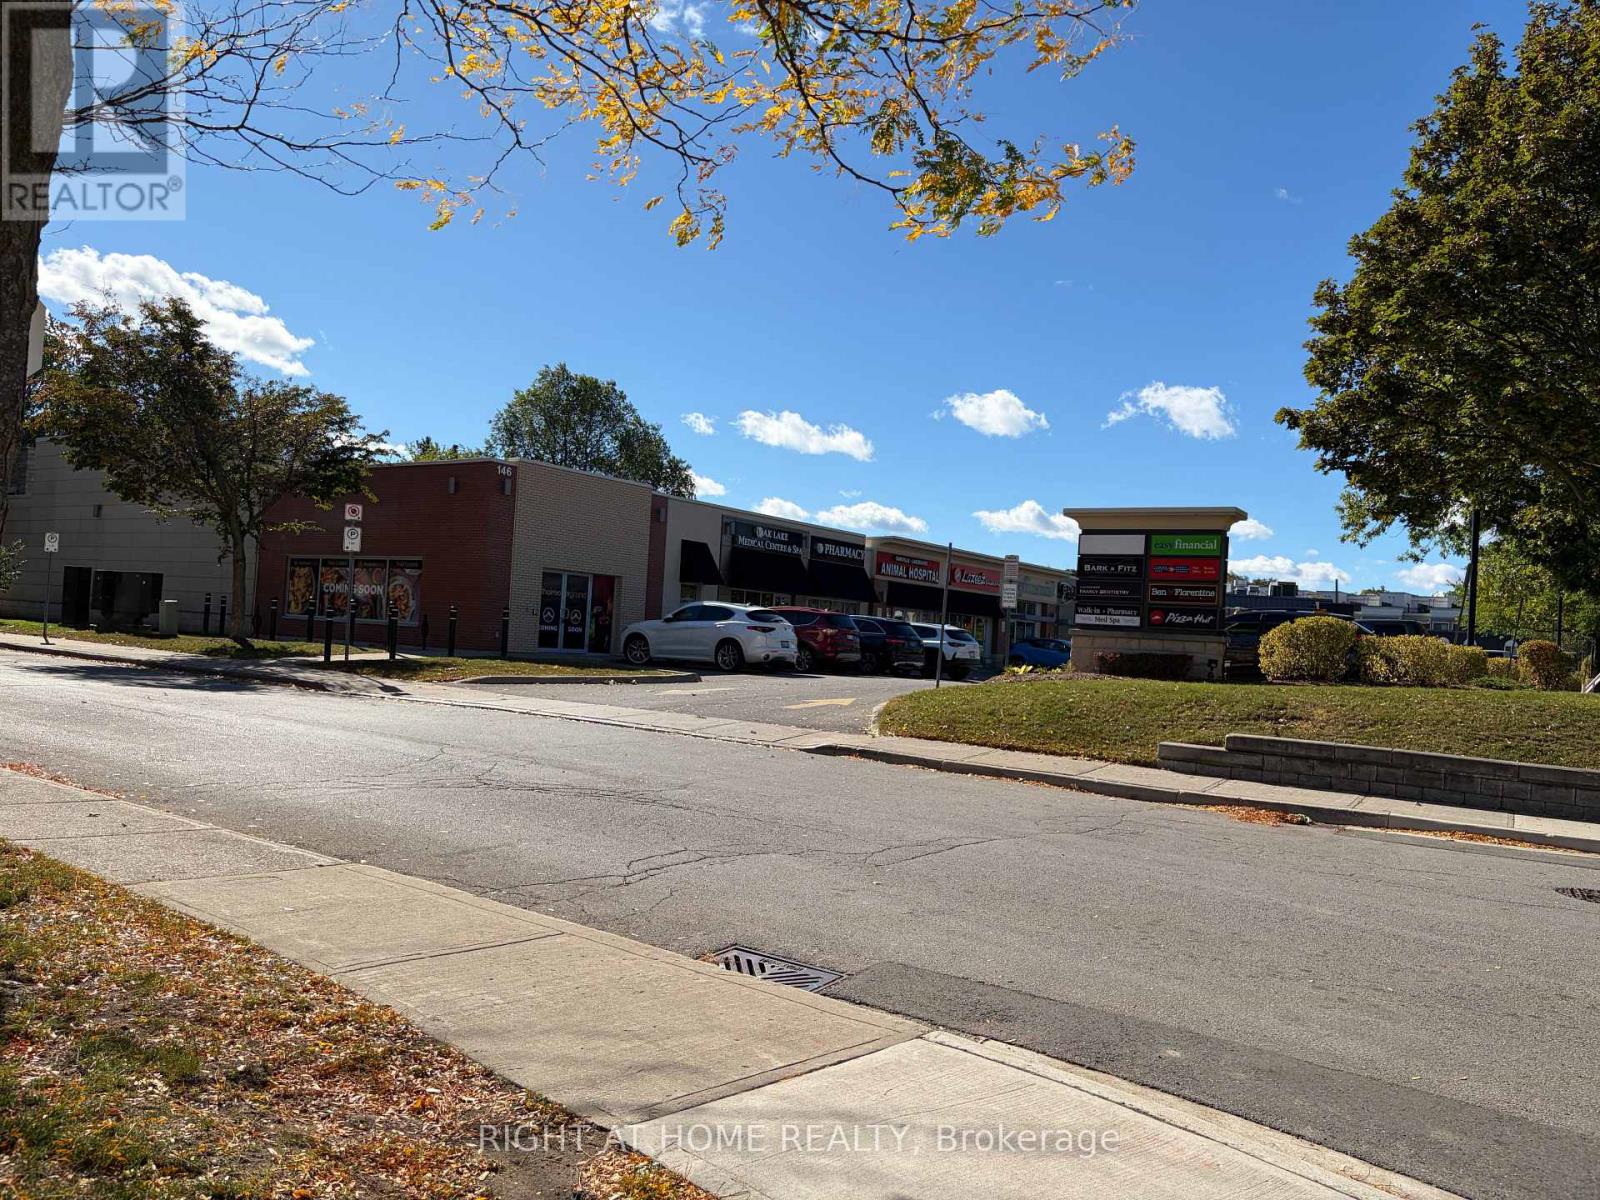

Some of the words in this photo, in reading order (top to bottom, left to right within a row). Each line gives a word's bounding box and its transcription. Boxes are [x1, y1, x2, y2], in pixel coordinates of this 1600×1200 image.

[497, 466, 512, 476] 146
[773, 530, 789, 540] LAKE
[825, 543, 865, 561] PHARMACY
[881, 562, 907, 578] ANIMAL
[909, 567, 939, 585] HOSPITAL
[1084, 564, 1108, 573] BARK
[1117, 564, 1137, 573] FITZ
[358, 584, 384, 595] SOON
[1174, 588, 1216, 598] Florentine
[1165, 612, 1193, 623] Pizza
[1193, 612, 1213, 624] Hut
